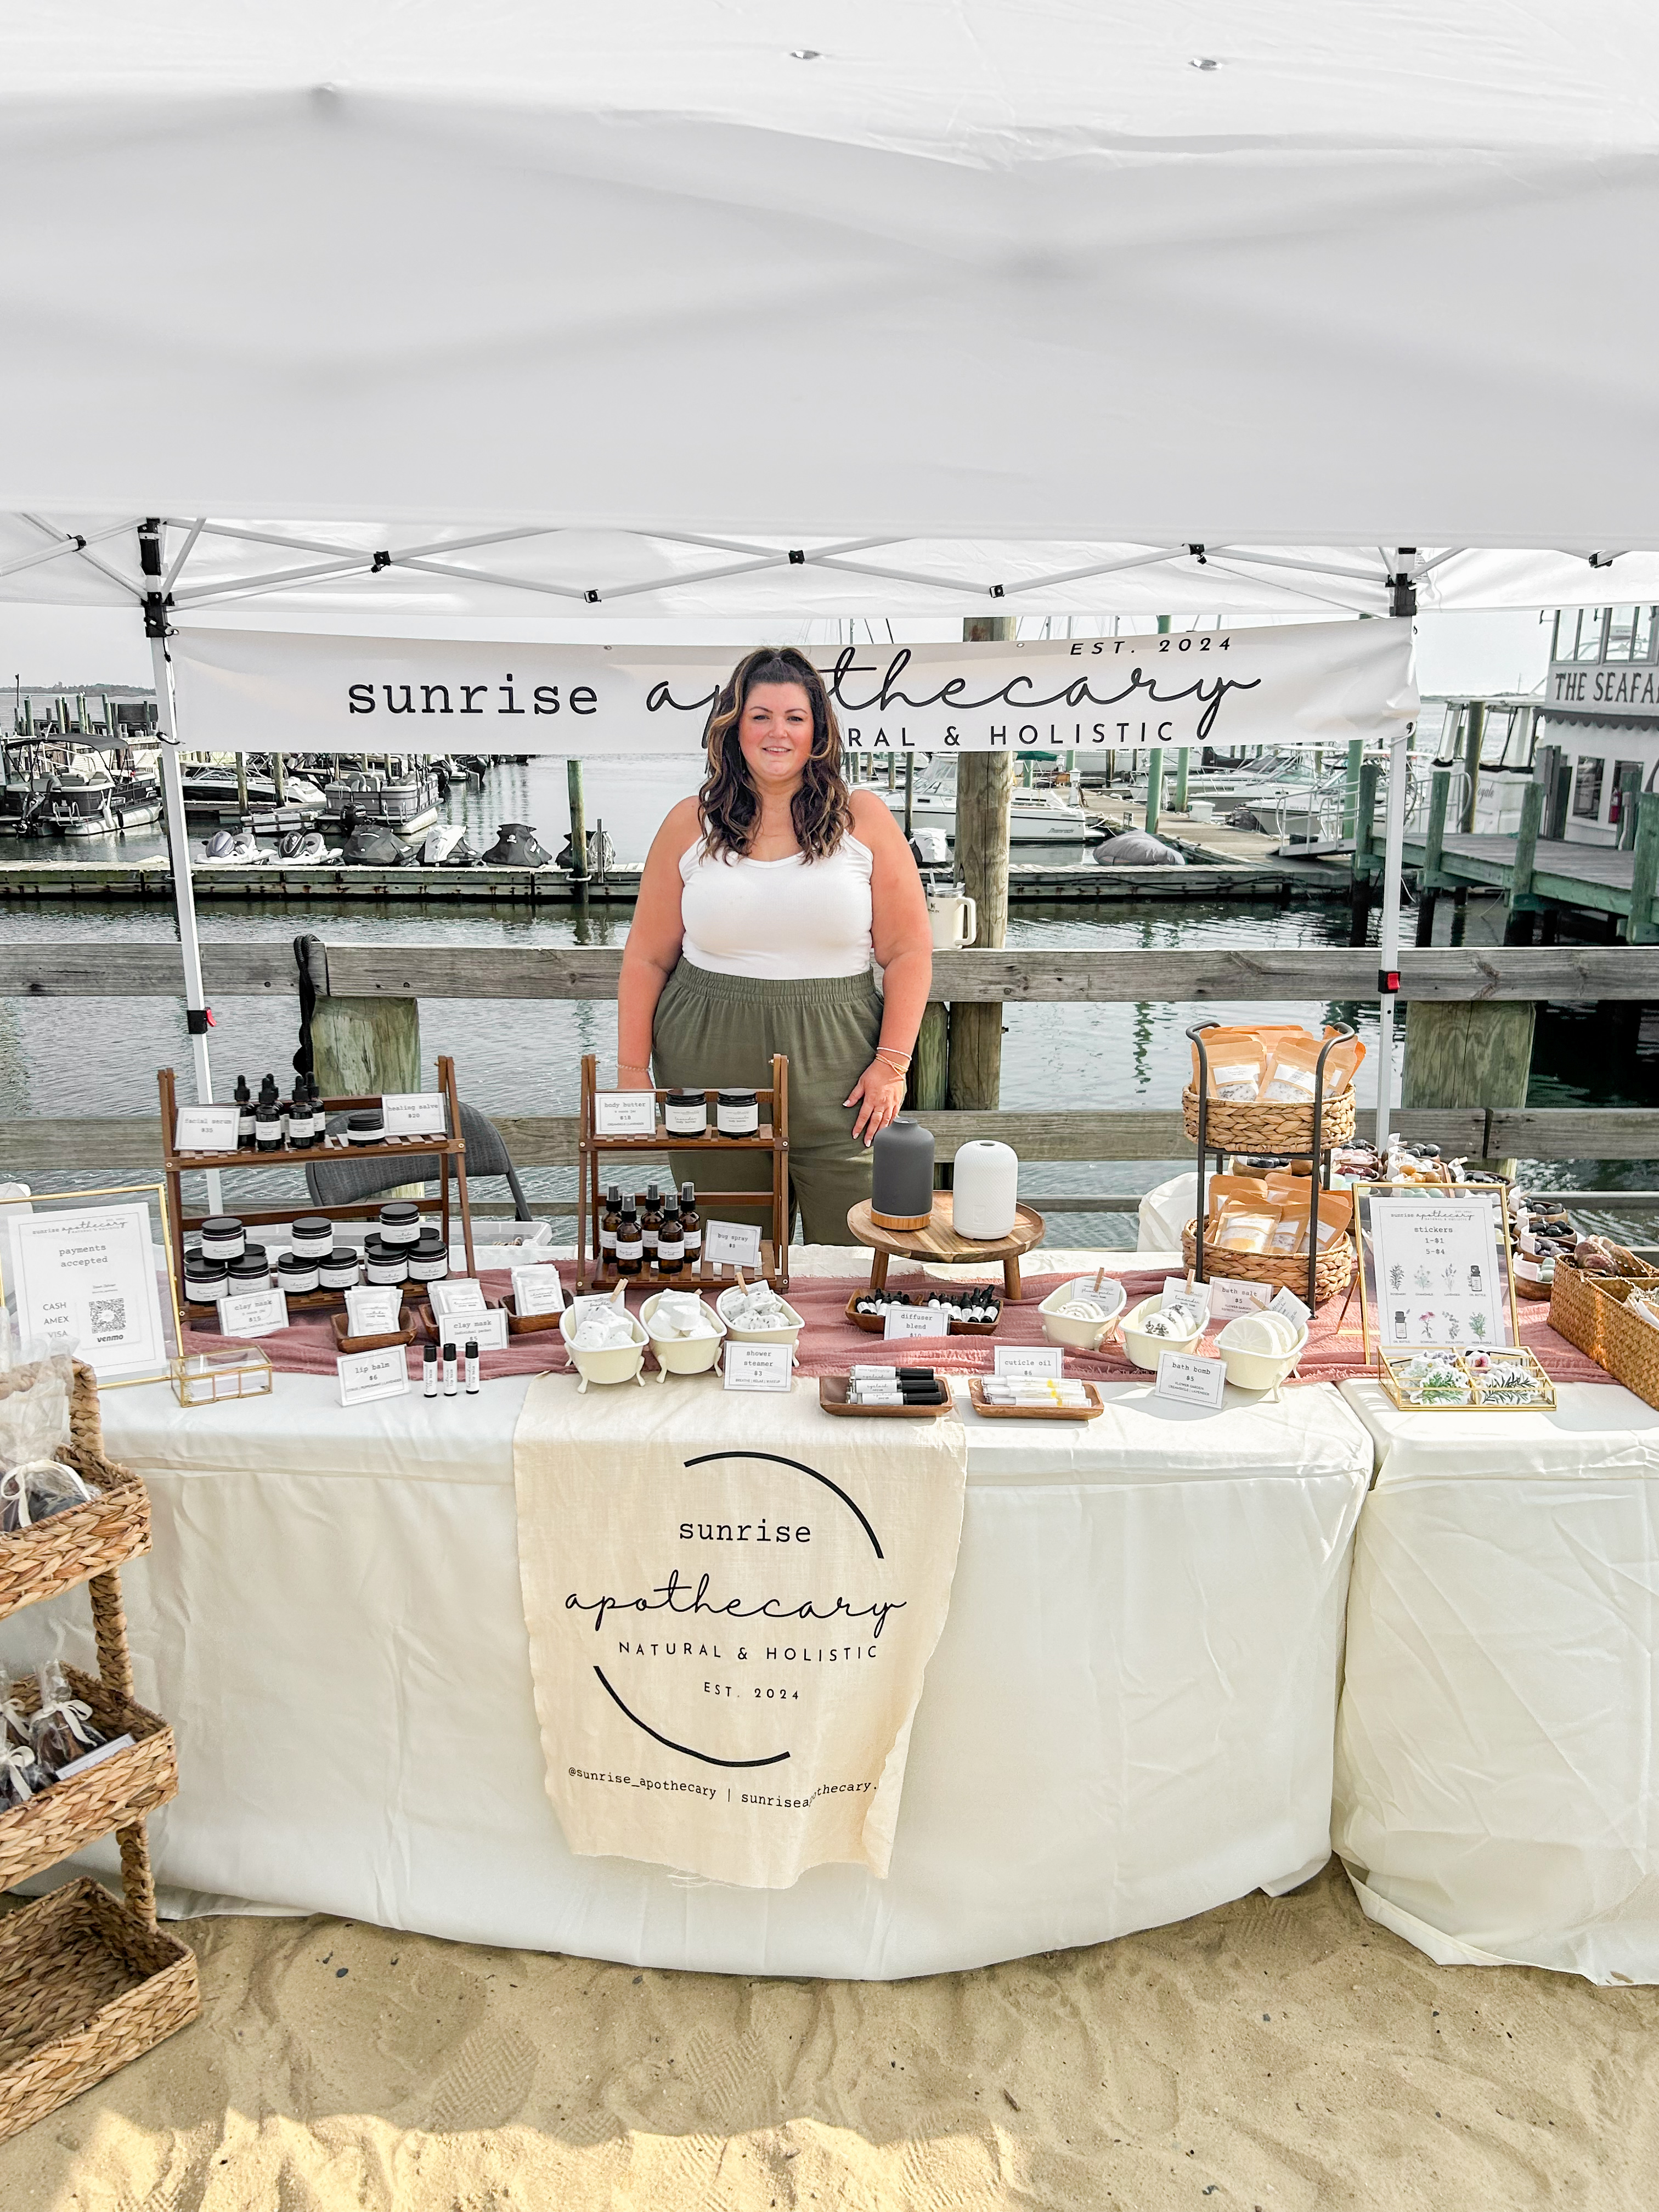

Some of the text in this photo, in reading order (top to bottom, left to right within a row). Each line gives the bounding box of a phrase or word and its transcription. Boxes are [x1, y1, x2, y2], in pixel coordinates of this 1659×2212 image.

[1070, 637, 1231, 656] EST. 2024
[1555, 672, 1659, 704] THE SEAFA
[348, 646, 1261, 749] sunrise apthecary
[944, 721, 1172, 746] & HOLISTIC
[1416, 1210, 1475, 1221] apothecary
[61, 1221, 128, 1234] apothecary
[59, 1244, 106, 1257] payments
[61, 1256, 108, 1268] accepted
[43, 1302, 67, 1311] CASH
[43, 1316, 69, 1325] AMEX
[47, 1330, 69, 1338] VISA
[97, 1334, 124, 1343] venmo
[371, 1362, 391, 1370] balm
[1172, 1362, 1211, 1375] bath bomb
[680, 1518, 811, 1543] sunrise
[565, 1569, 907, 1639] apothecary
[619, 1641, 877, 1662] NATURAL & HOLISTIC
[704, 1681, 799, 1701] EST. 2024
[568, 1767, 717, 1800] @sunrise_apothecary
